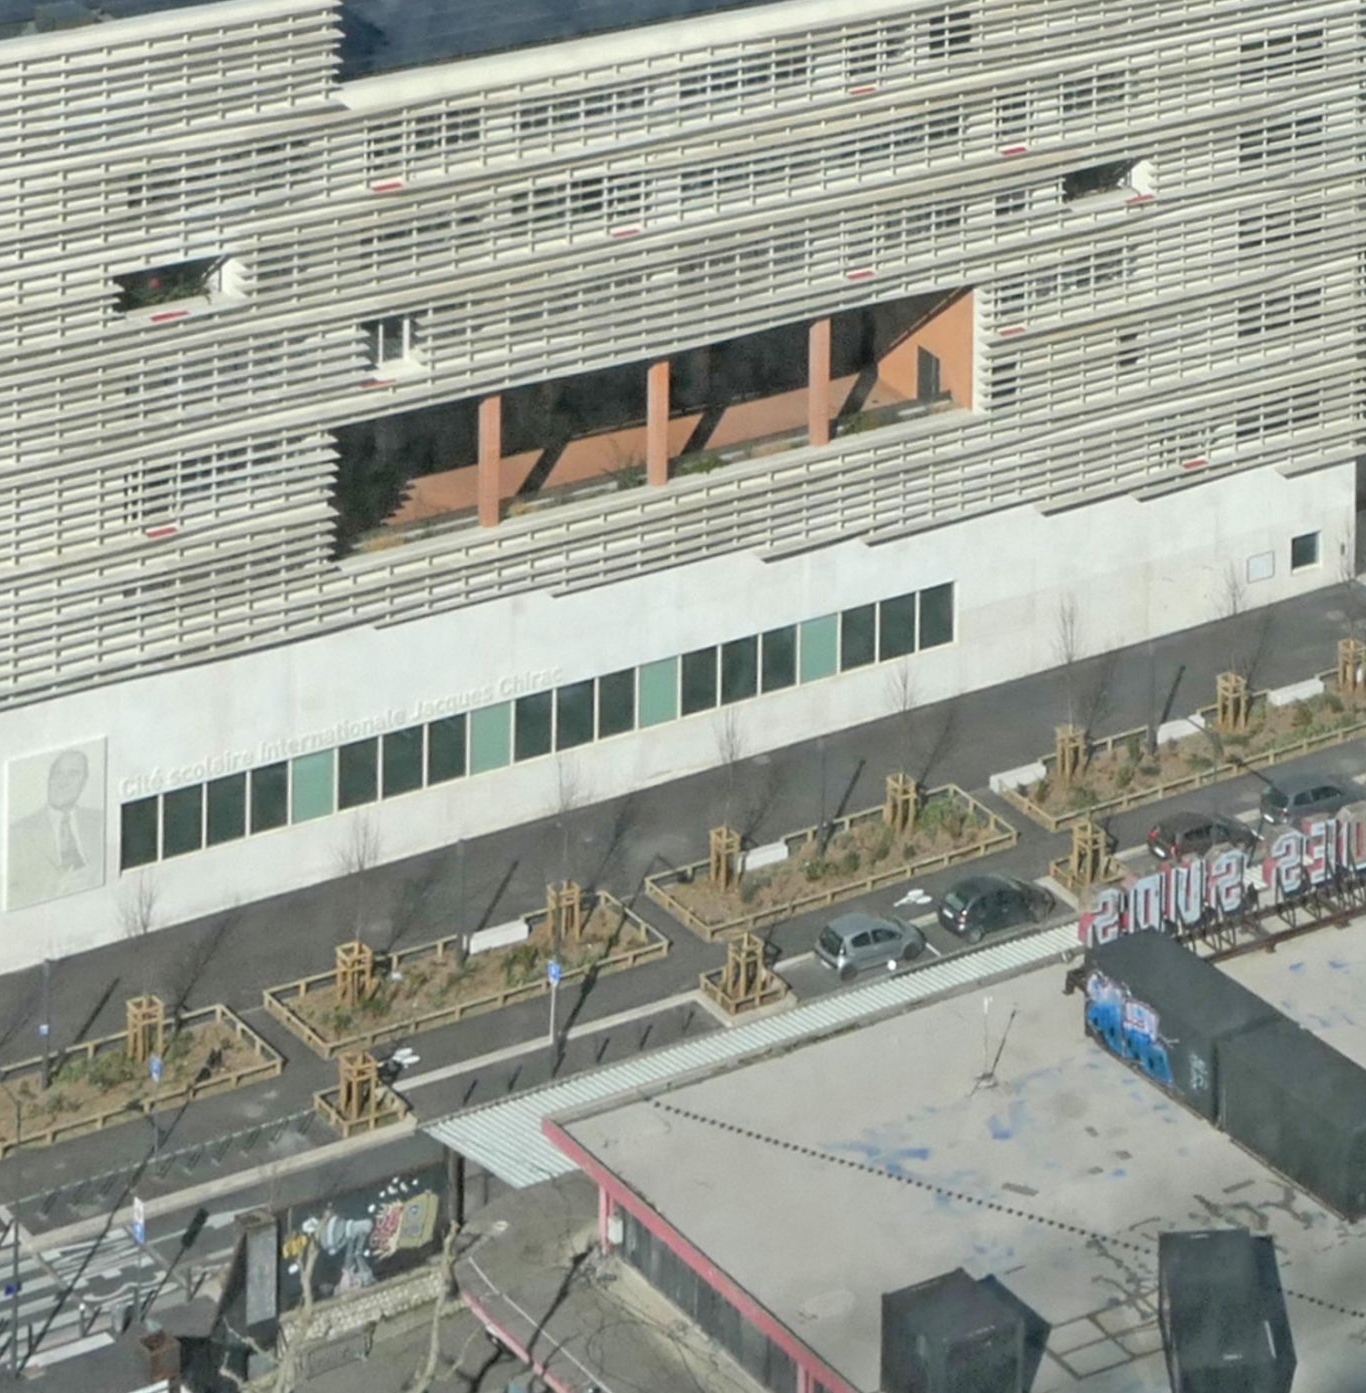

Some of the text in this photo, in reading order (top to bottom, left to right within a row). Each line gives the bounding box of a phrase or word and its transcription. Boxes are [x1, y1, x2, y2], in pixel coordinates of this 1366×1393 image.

[120, 765, 164, 798] Cité
[167, 749, 254, 787] scolaire
[410, 684, 494, 722] Jacques
[498, 666, 564, 698] Chirac
